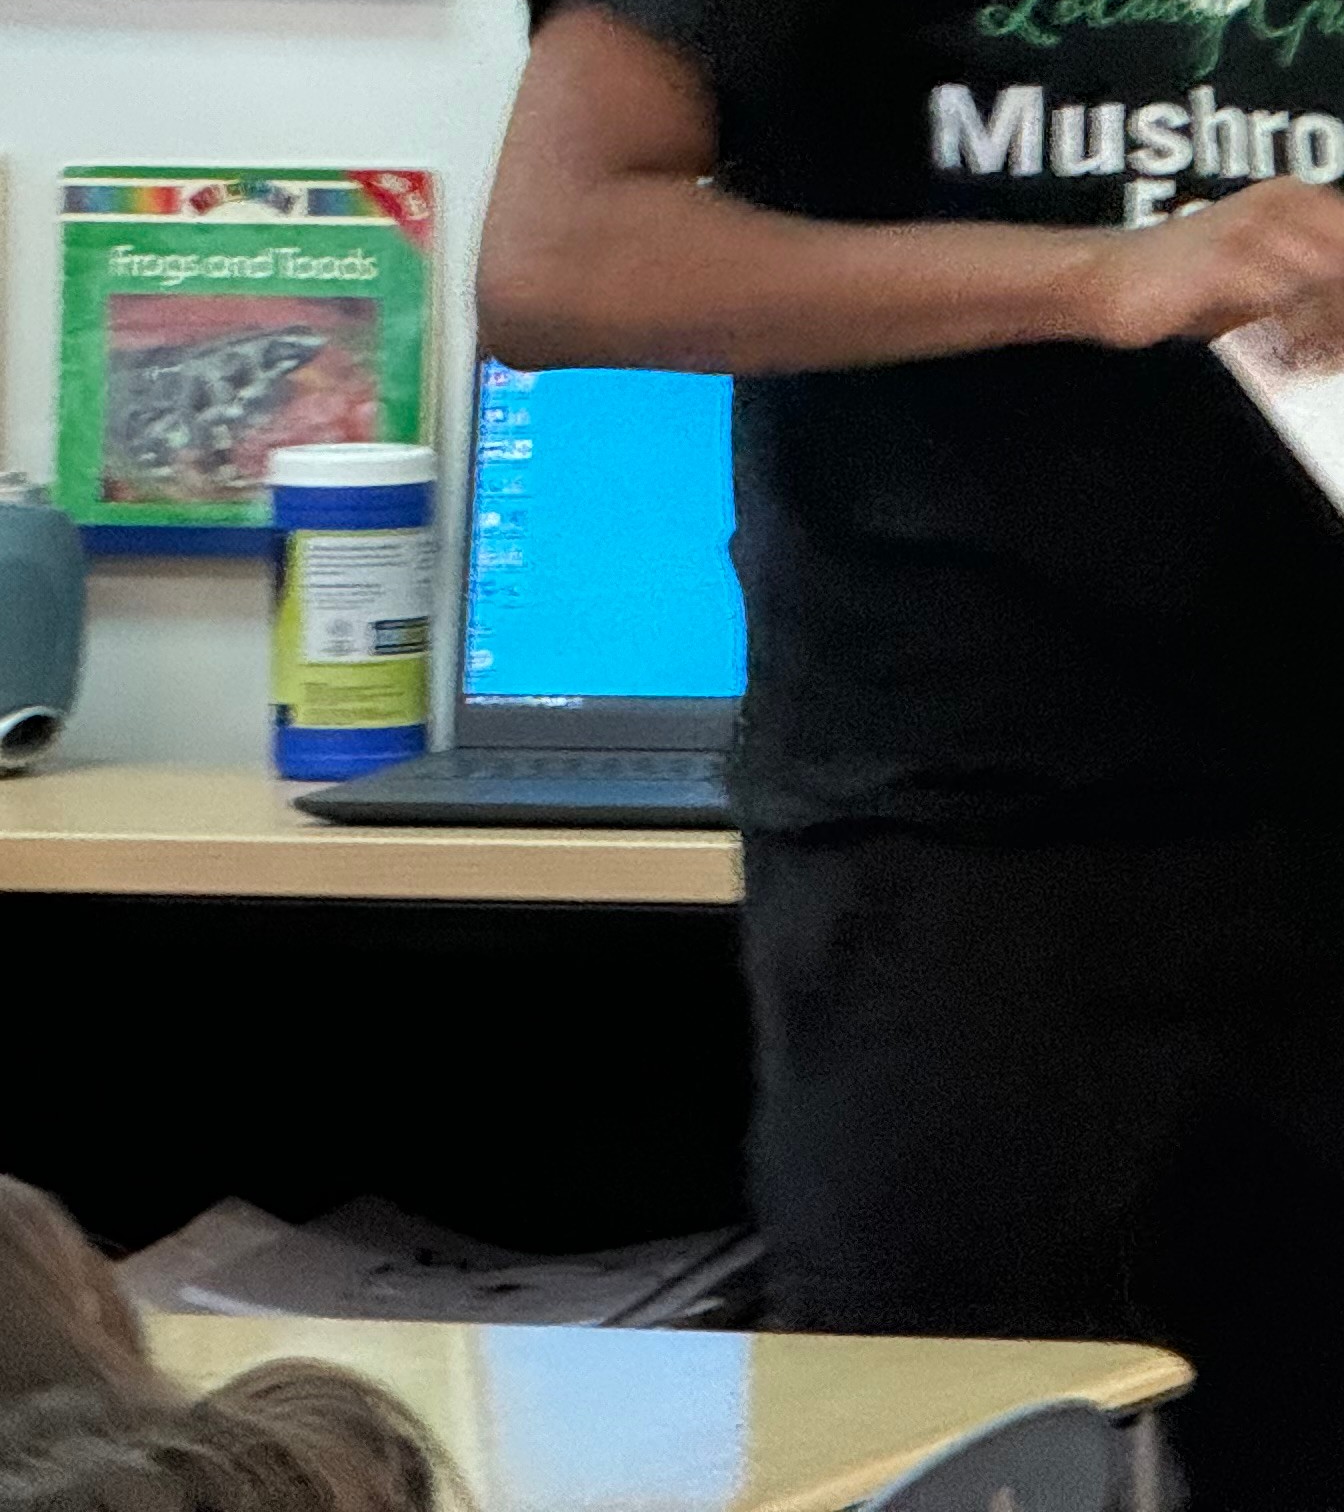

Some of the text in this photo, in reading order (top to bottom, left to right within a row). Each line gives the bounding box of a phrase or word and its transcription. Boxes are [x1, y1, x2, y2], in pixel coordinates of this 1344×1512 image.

[107, 245, 381, 287] Frogs and Toads
